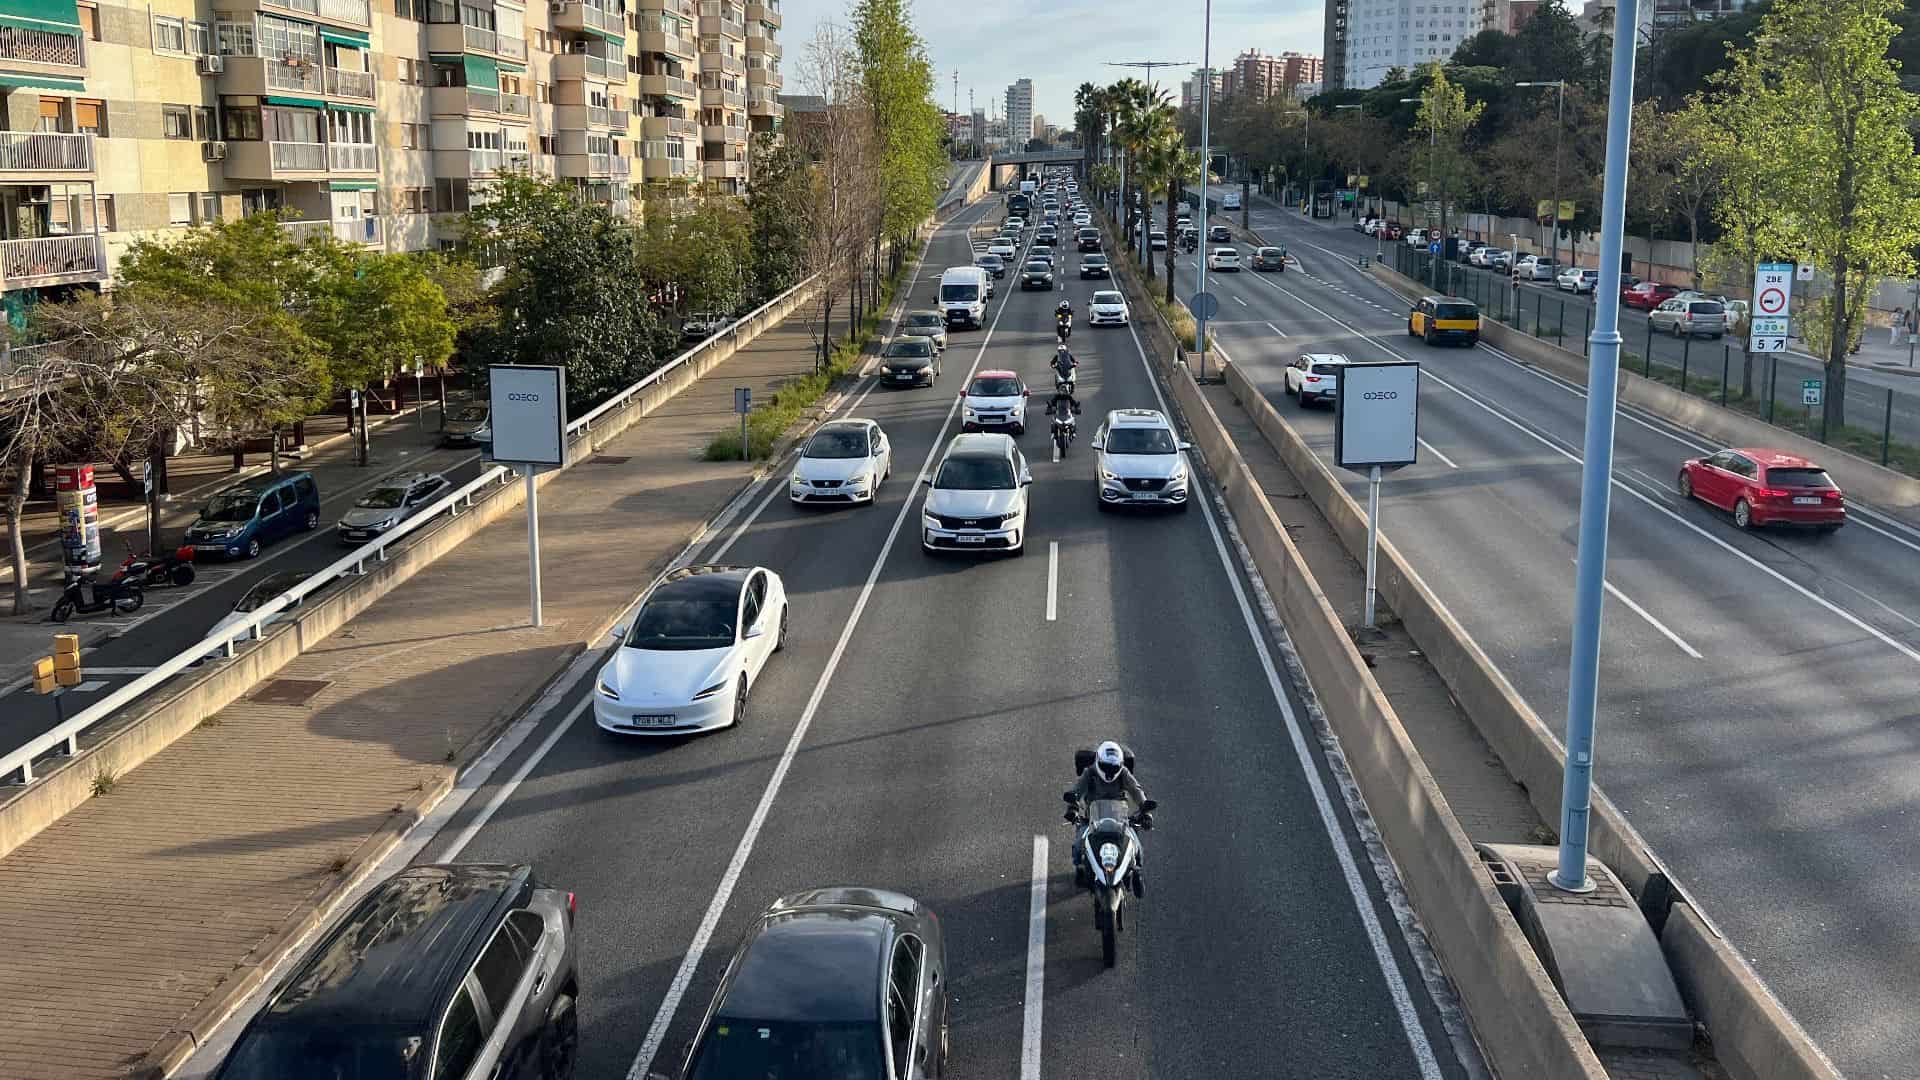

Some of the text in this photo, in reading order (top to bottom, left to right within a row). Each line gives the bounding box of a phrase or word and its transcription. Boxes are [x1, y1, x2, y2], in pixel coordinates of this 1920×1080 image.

[1765, 275, 1783, 283] ZBE
[1758, 339, 1765, 350] 5
[508, 393, 539, 401] ODECO
[1363, 391, 1397, 400] ODECO
